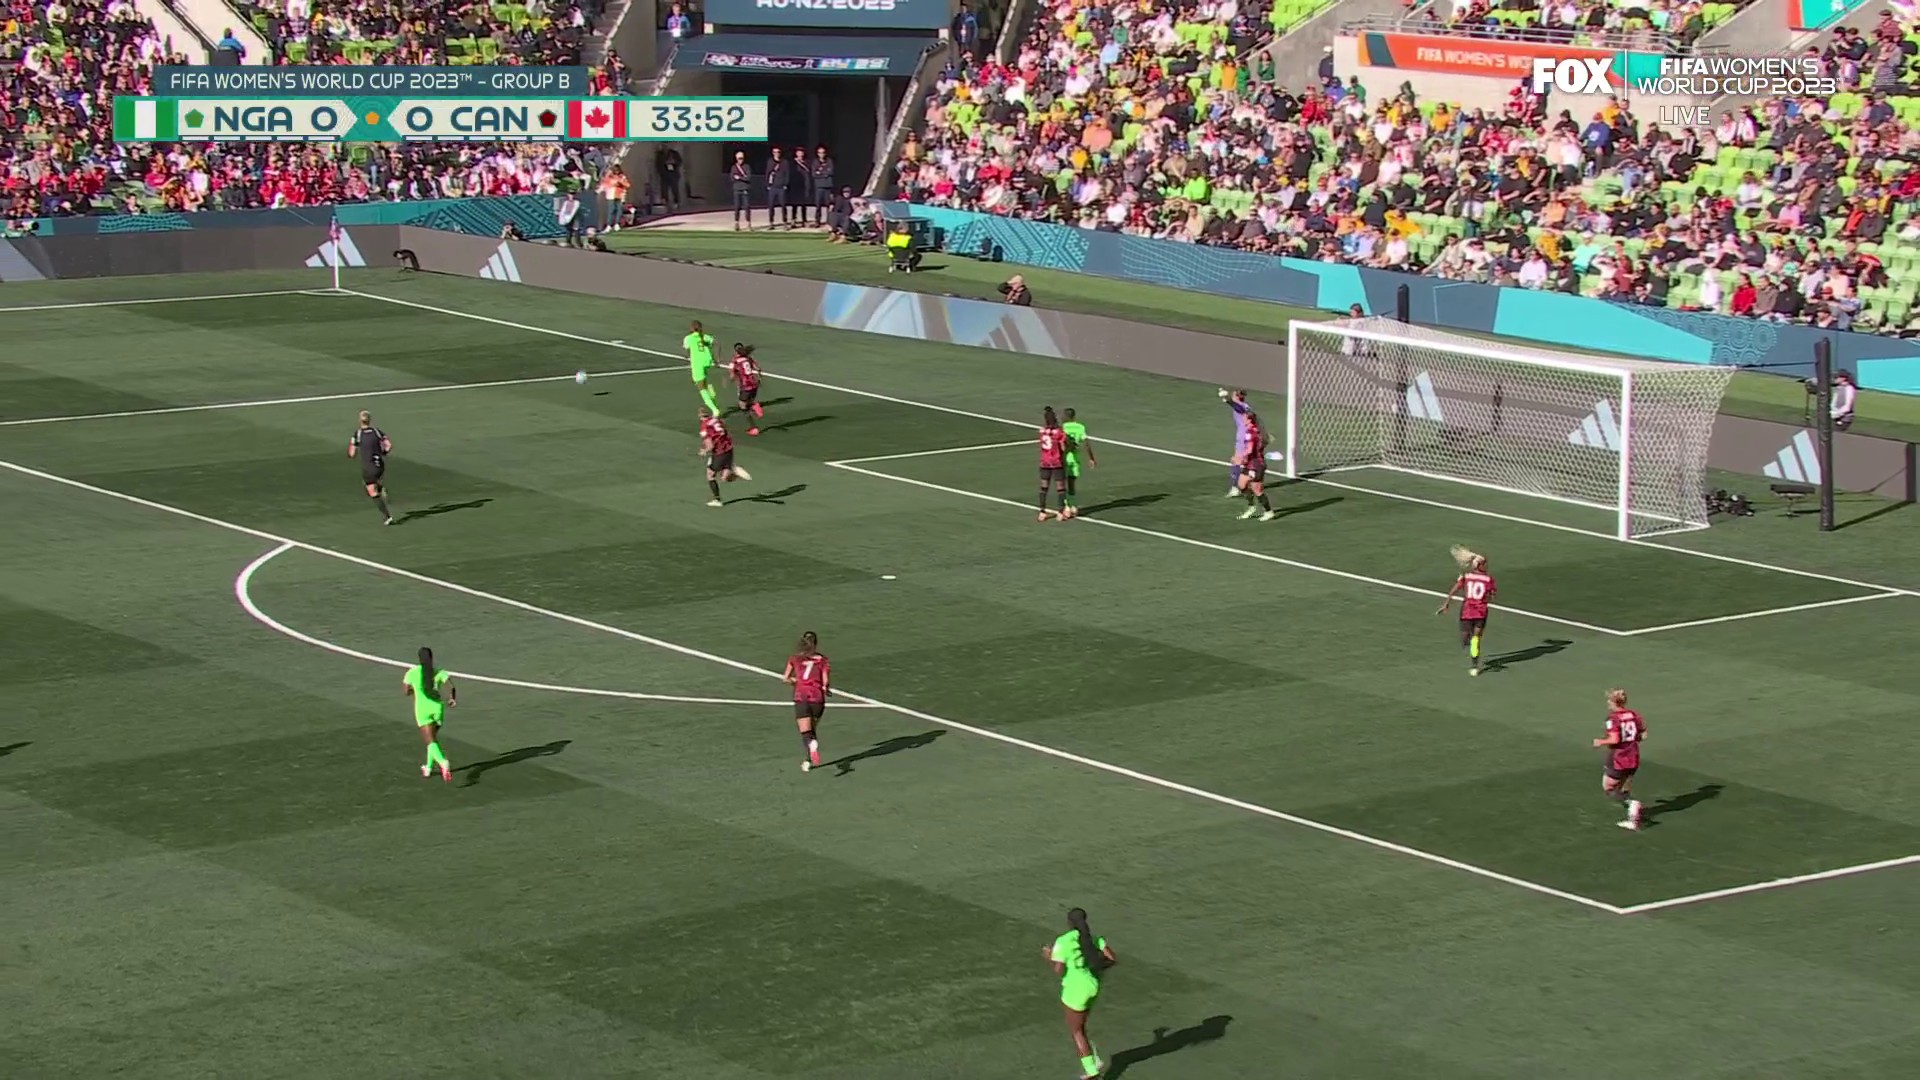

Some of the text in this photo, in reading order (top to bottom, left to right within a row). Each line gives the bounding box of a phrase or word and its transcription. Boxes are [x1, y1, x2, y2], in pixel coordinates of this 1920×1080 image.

[1417, 47, 1443, 62] FIFA
[1041, 434, 1053, 450] 3
[1467, 580, 1485, 600] 10
[802, 660, 815, 680] 7
[1620, 720, 1637, 742] 19
